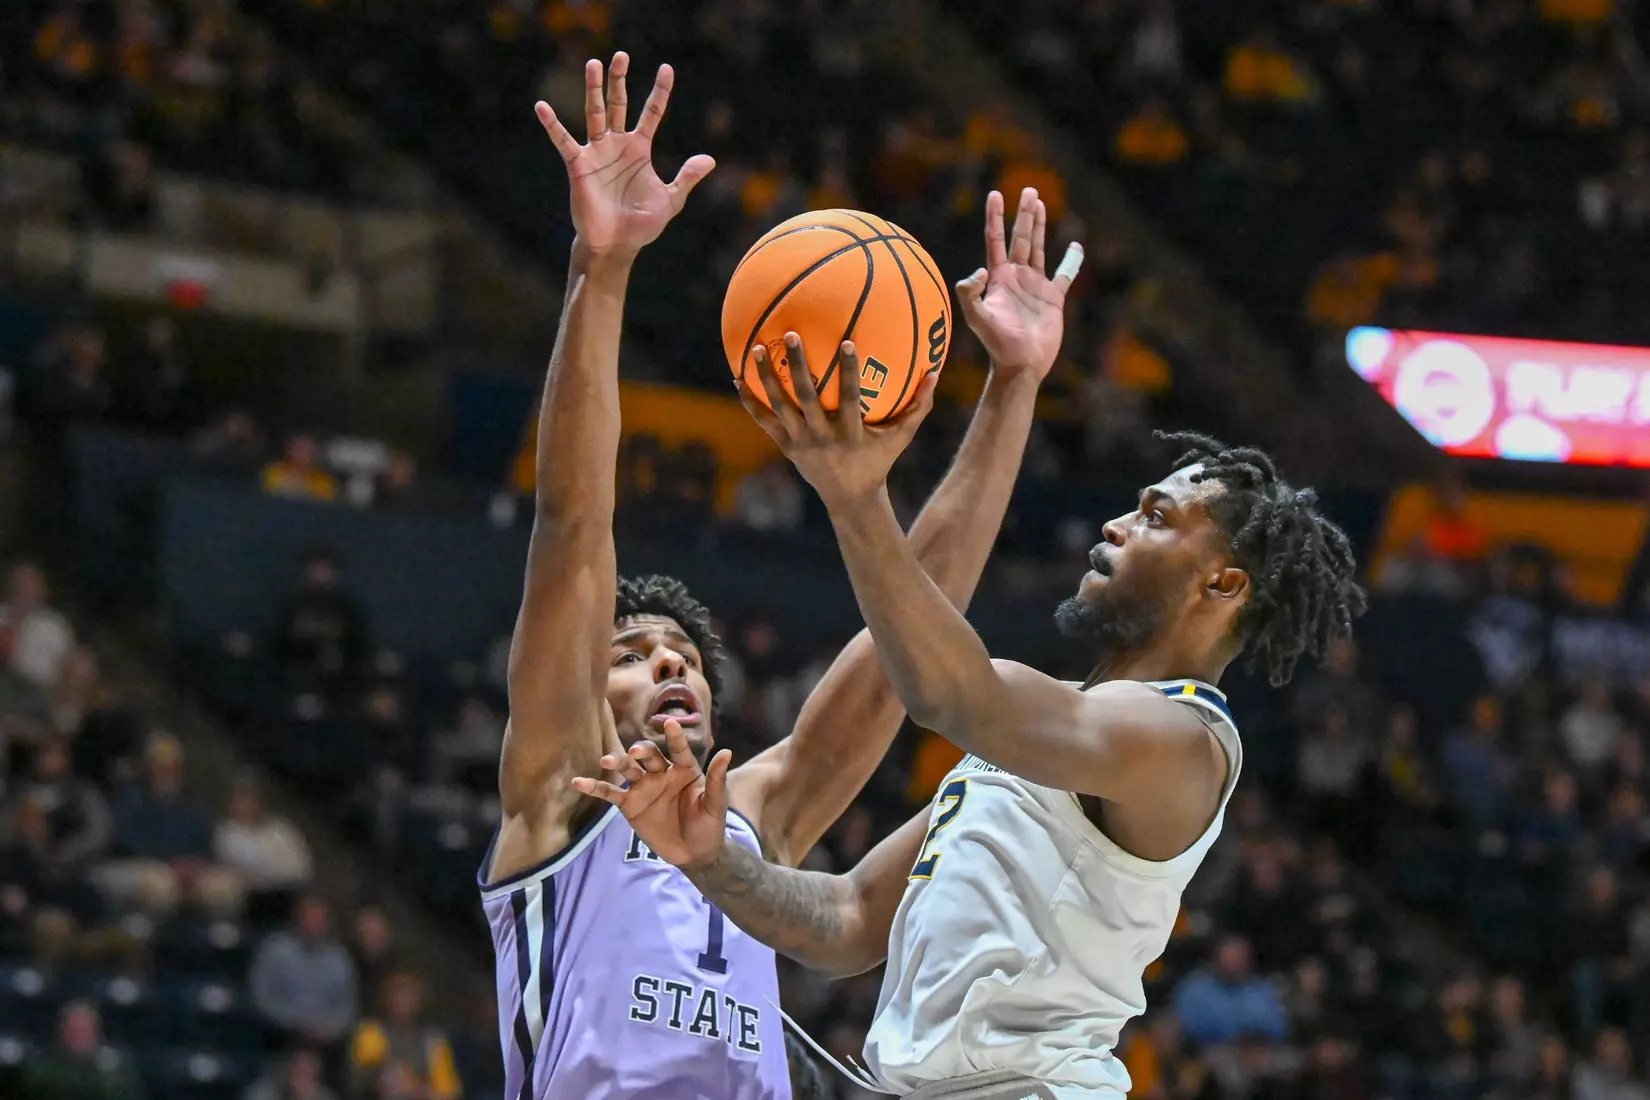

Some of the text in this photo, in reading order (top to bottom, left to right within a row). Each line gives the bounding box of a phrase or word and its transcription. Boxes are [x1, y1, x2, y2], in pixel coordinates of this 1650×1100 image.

[908, 776, 968, 880] 2
[697, 896, 728, 975] 1
[628, 974, 763, 1054] STATE
